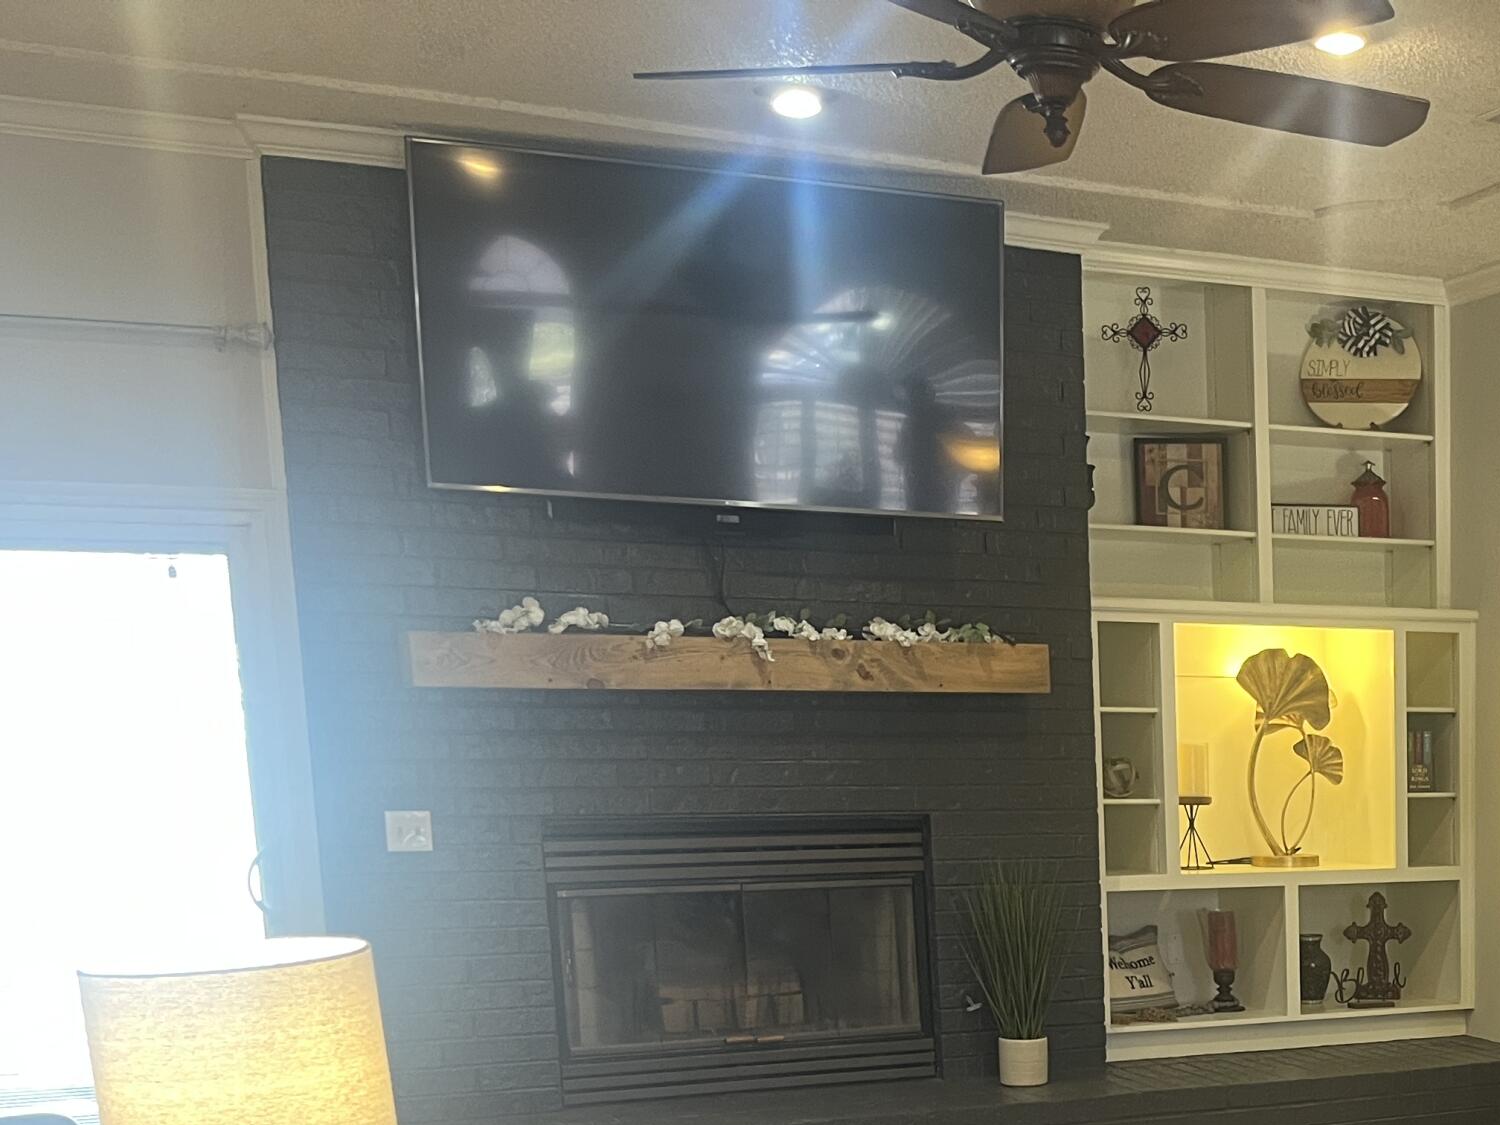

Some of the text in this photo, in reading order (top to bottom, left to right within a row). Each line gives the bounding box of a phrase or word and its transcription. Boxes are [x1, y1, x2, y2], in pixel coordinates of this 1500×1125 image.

[1307, 359, 1350, 377] SIMPLY
[1159, 465, 1205, 512] C
[1283, 508, 1320, 535] FAMILY
[1327, 509, 1355, 537] EVER
